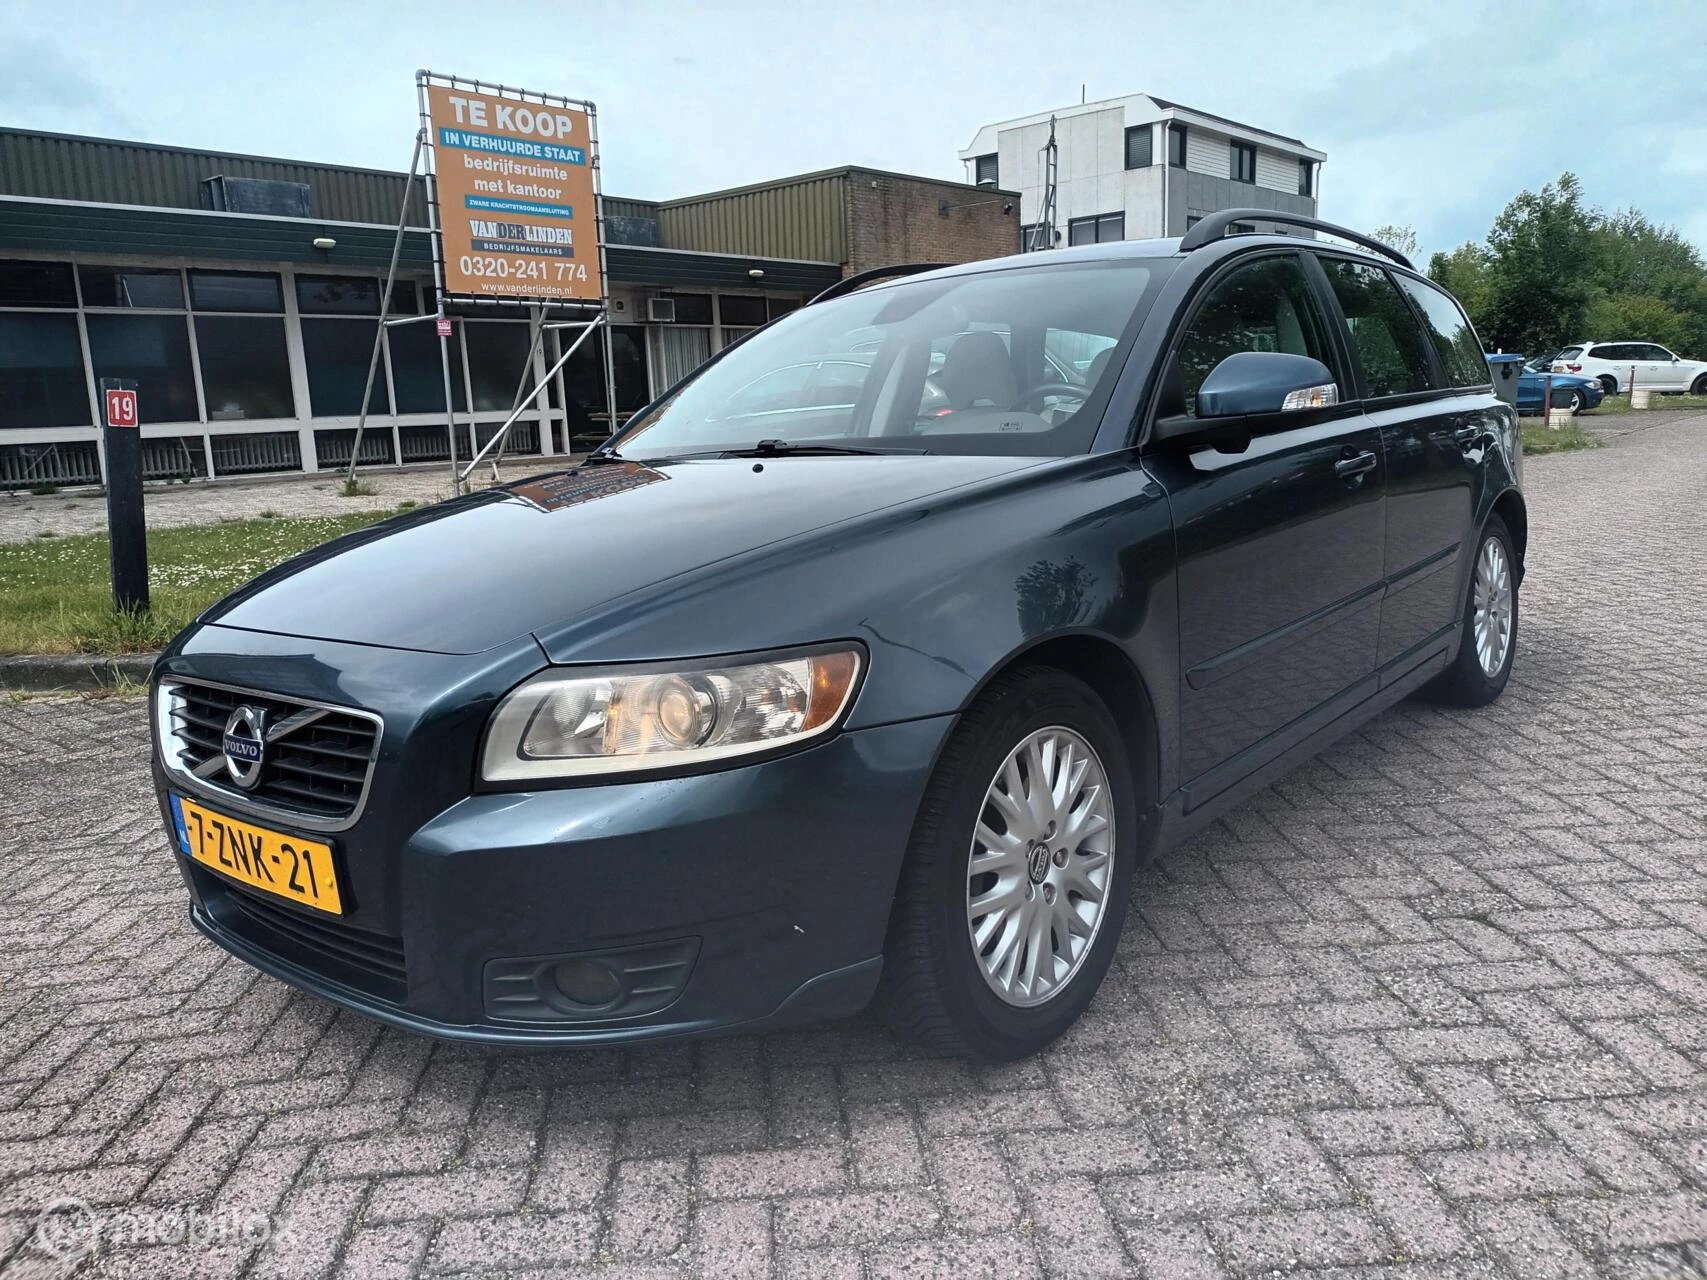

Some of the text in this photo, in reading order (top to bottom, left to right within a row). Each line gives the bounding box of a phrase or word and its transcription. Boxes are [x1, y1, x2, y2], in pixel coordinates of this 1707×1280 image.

[449, 96, 573, 139] TE KOOP
[445, 132, 580, 162] IN VERHUURDE STAAT
[464, 154, 568, 180] bedrijfsruimte
[474, 178, 562, 199] met kantoor
[469, 199, 569, 215] ZWARE KRACHTSTROOMAANSLUITING
[484, 242, 562, 255] BEDRIJFSMAKELAARS
[460, 255, 587, 282] 0320-241 774
[481, 282, 573, 295] www.vanderlinden.nl
[111, 396, 133, 421] 19
[224, 739, 258, 757] VOLVO
[179, 828, 190, 845] NL
[189, 810, 319, 899] 7-ZNK-21
